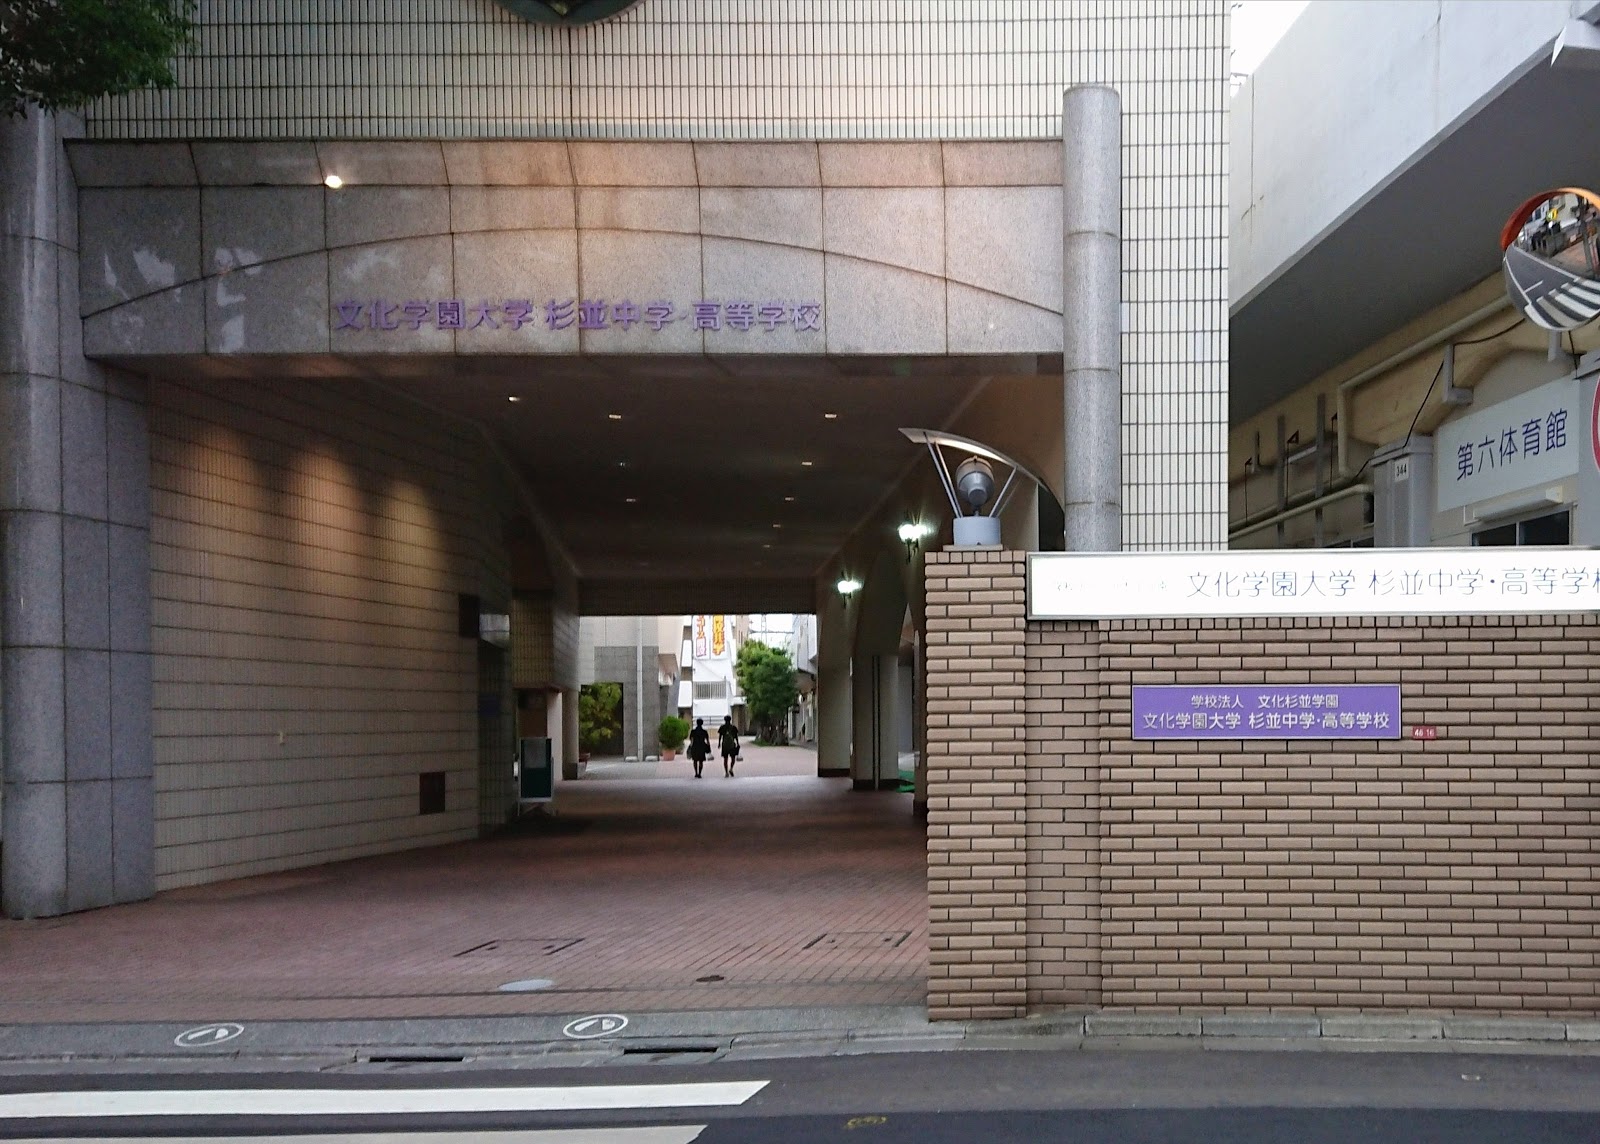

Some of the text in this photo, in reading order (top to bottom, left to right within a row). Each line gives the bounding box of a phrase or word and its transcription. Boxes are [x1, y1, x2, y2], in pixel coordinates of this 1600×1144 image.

[334, 300, 533, 331] 文化学園大学
[1456, 407, 1568, 481] 第六体育館
[1186, 570, 1356, 598] 文化学園大学
[1191, 694, 1339, 709] 学校法人 文化杉並学園
[1143, 712, 1241, 729] 文化学園大学
